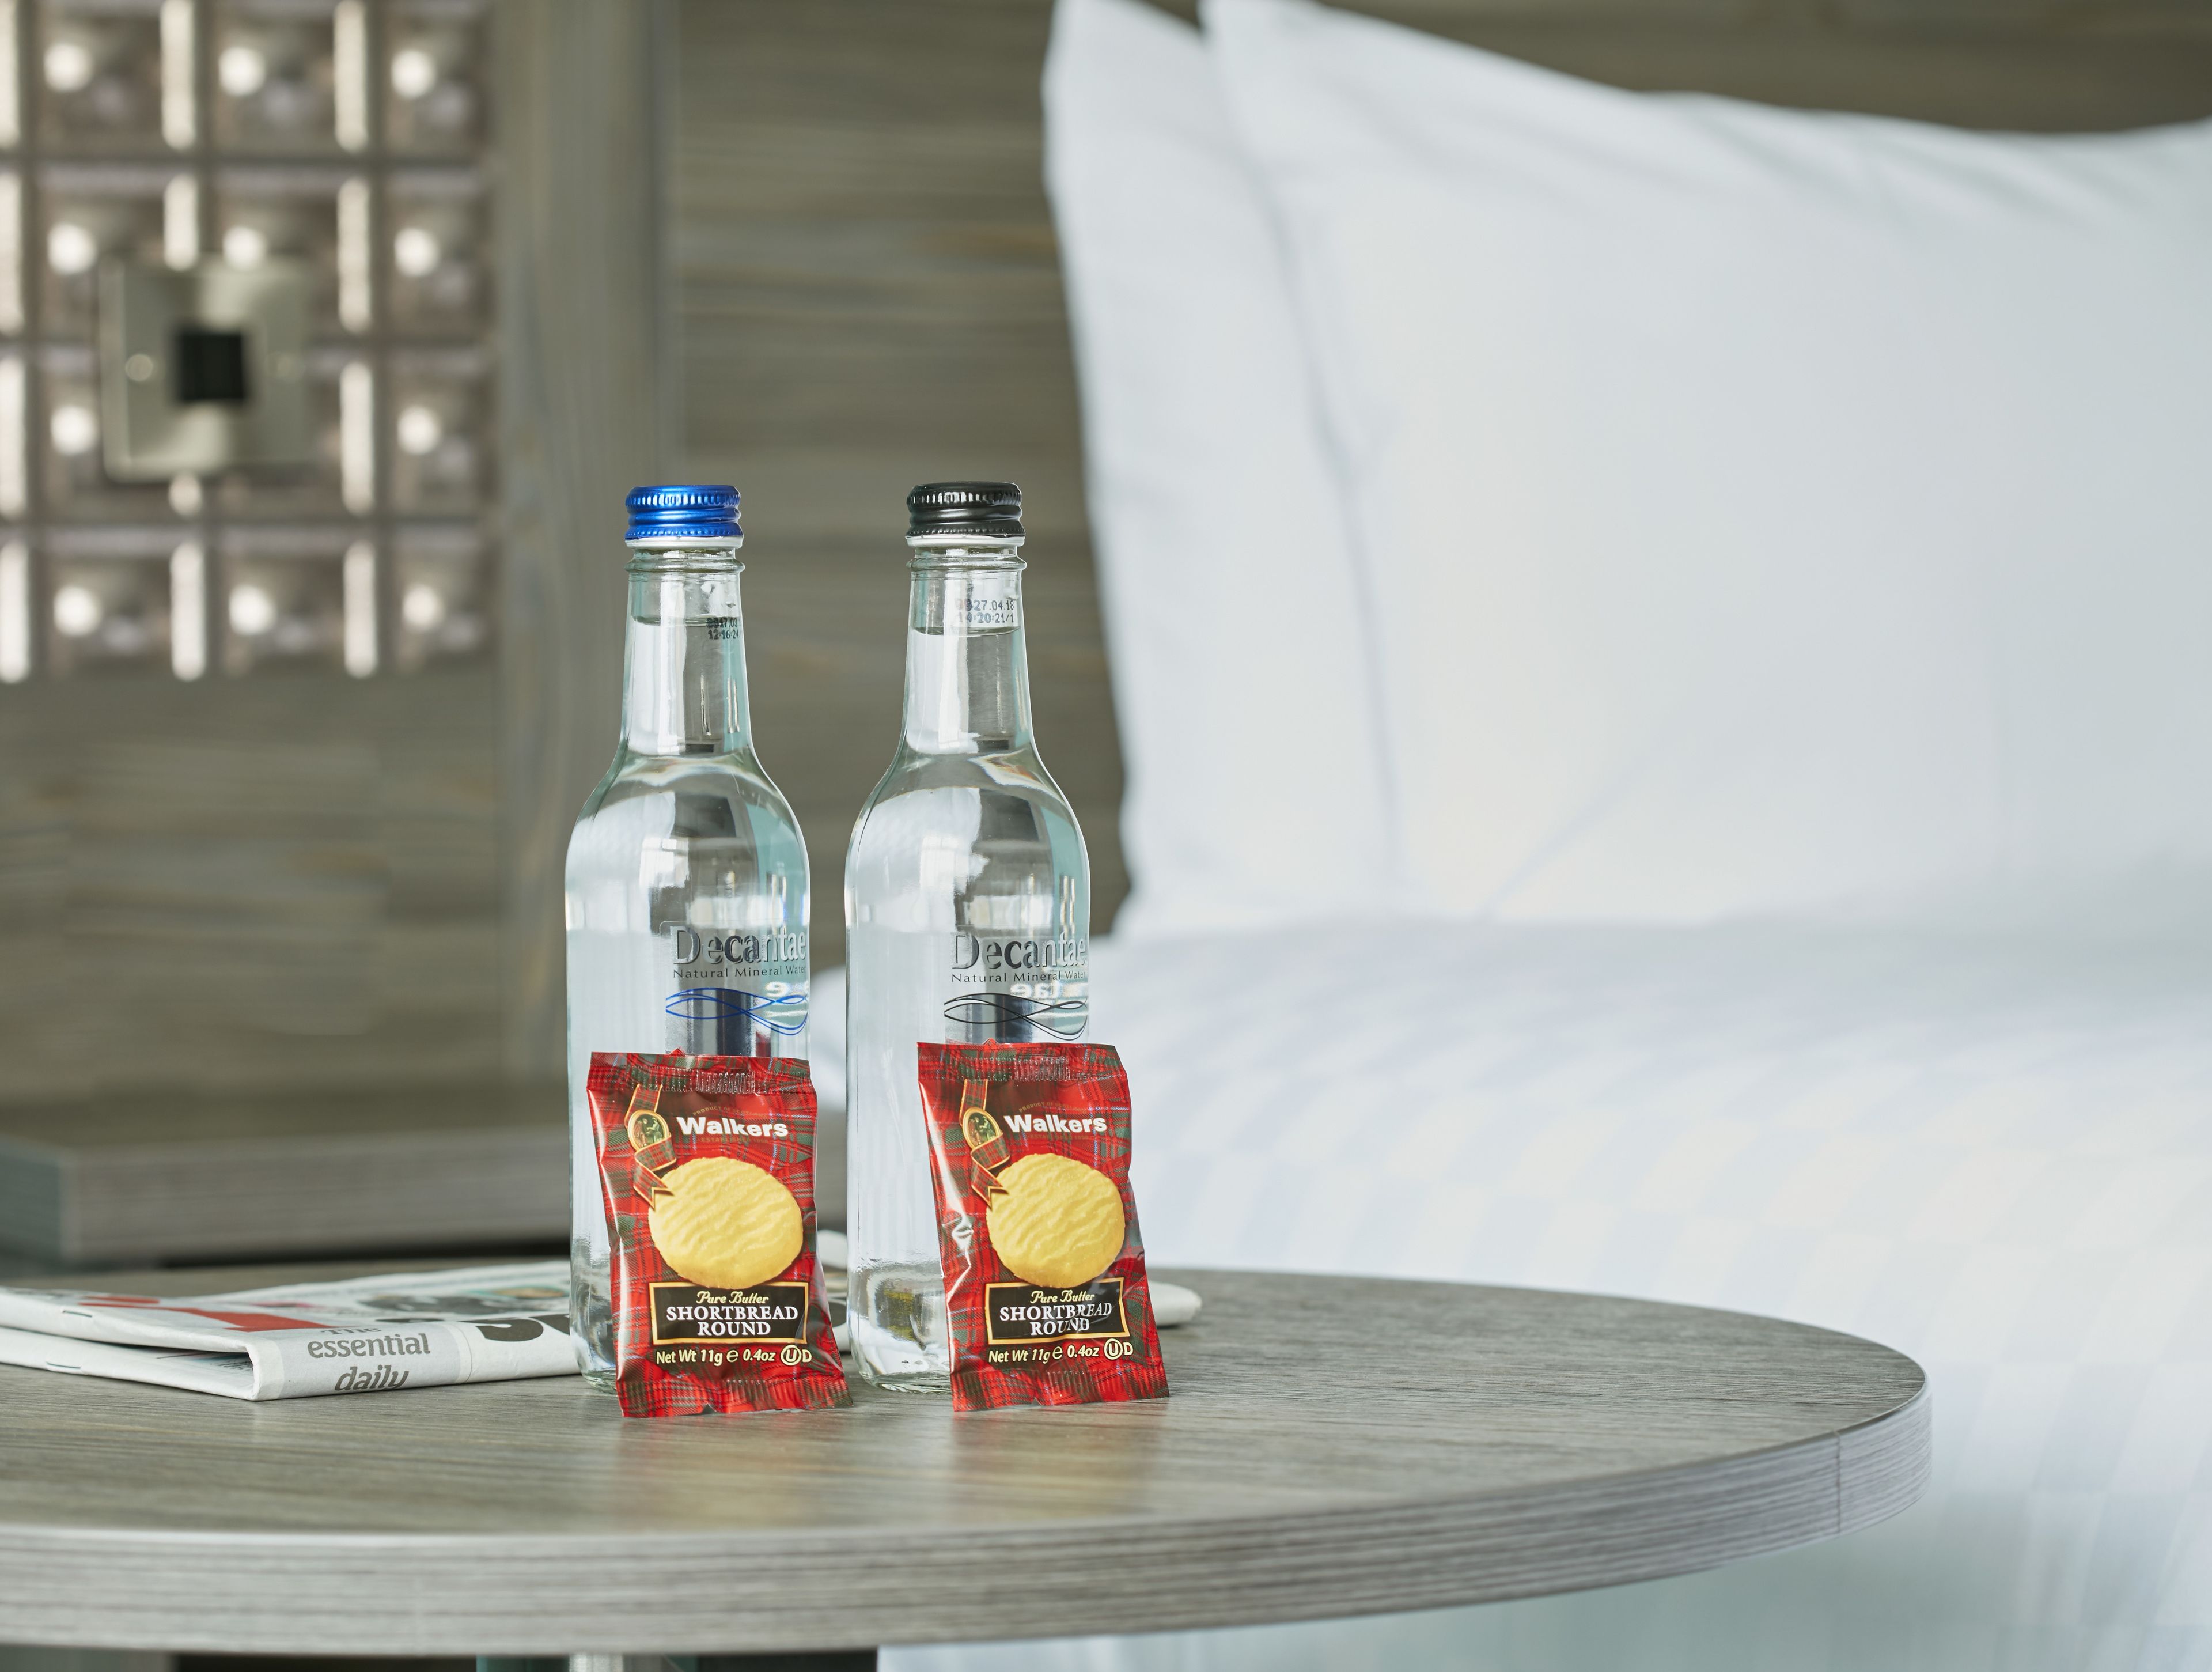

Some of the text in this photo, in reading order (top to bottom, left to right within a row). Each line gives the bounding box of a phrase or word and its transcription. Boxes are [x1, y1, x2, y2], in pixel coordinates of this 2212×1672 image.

[670, 925, 806, 965] Decantae
[951, 931, 1087, 970] Decantae
[673, 966, 806, 978] Natural Mineral Water
[952, 971, 1086, 982] Natural Mineral Water
[692, 1106, 722, 1116] PRODUCT
[1018, 1102, 1045, 1113] PRODUCT
[676, 1116, 790, 1137] Walkers
[1003, 1114, 1107, 1133] Walkers
[696, 1291, 769, 1304] Pure Butter
[1030, 1289, 1095, 1303] Pure Butter
[666, 1306, 798, 1322] SHORTBREAD
[999, 1302, 1112, 1322] SHORTBREAD
[697, 1321, 771, 1337] ROUND
[1031, 1318, 1090, 1336] ROUND
[307, 1333, 431, 1359] essential
[988, 1349, 1009, 1363] Net
[1012, 1349, 1029, 1362] Wt
[1032, 1348, 1051, 1364] 11g
[1067, 1345, 1099, 1358] 0.4oz
[656, 1350, 676, 1364] Net
[679, 1349, 697, 1363] Wt
[700, 1349, 723, 1367] 11g
[743, 1348, 775, 1362] 0.4oz
[334, 1364, 410, 1391] daily
